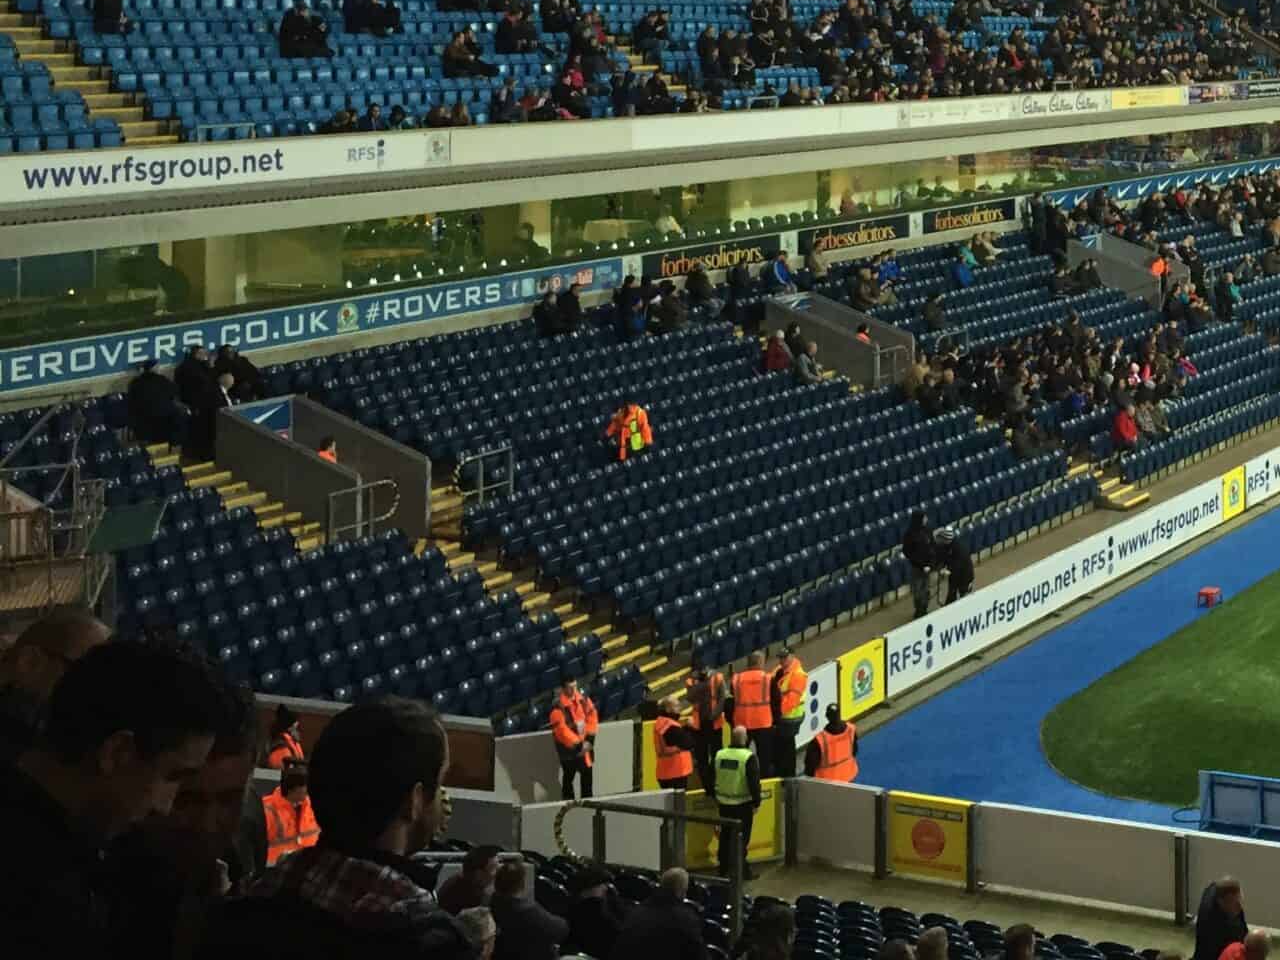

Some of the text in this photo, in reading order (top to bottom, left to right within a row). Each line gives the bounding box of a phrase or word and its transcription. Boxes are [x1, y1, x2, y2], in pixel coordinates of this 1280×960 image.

[23, 148, 284, 190] www.rfsgroup.net
[347, 145, 376, 161] RFS
[365, 282, 501, 324] #ROVERS
[0, 308, 329, 385] EROVERS.CO.UK
[1247, 470, 1266, 492] RFS
[1081, 493, 1220, 579] RFS www.rfsgroup.net
[889, 565, 1077, 677] RFS www.rfsgroup.net
